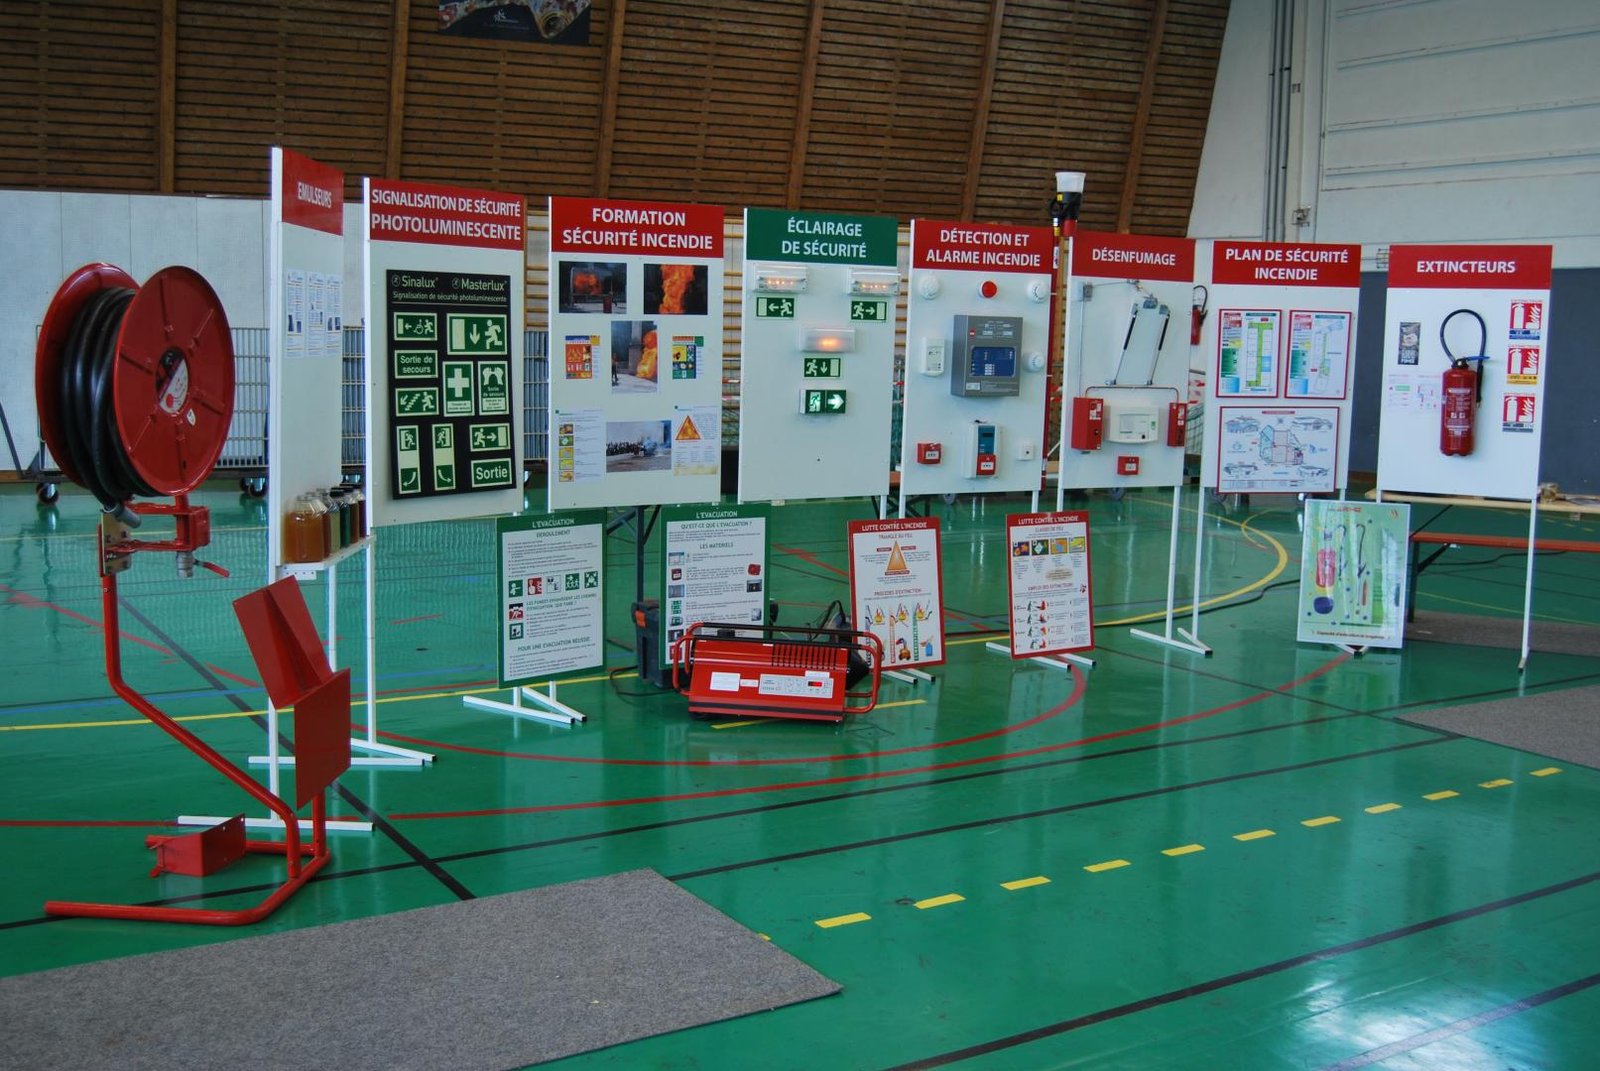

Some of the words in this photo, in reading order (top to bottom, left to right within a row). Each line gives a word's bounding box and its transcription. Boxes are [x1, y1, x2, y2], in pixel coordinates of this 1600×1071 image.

[298, 181, 332, 208] EMULSEURS
[372, 189, 456, 211] SIGNALISATION
[458, 199, 472, 212] DE
[474, 198, 520, 217] SÉCURITÉ
[592, 208, 686, 226] FORMATION
[371, 213, 521, 240] PHOTOLUMINESCENTE
[788, 217, 862, 236] ÉCLAIRAGE
[562, 227, 638, 246] SÉCURITÉ
[642, 233, 712, 250] INCENDIE
[940, 228, 1012, 246] DÉTECTION
[1014, 234, 1030, 246] ET
[782, 240, 800, 254] DE
[804, 240, 866, 258] SÉCURITÉ
[926, 250, 980, 264] ALARME
[982, 252, 1040, 266] INCENDIE
[1092, 247, 1176, 266] DÉSENFUMAGE
[1226, 248, 1261, 260] PLAN
[1264, 250, 1282, 262] DE
[1286, 248, 1348, 263] SÉCURITÉ
[1255, 268, 1318, 280] INCENDIE
[1416, 260, 1516, 273] EXTINCTEURS
[400, 356, 422, 364] Sortie
[476, 466, 508, 480] Sortie
